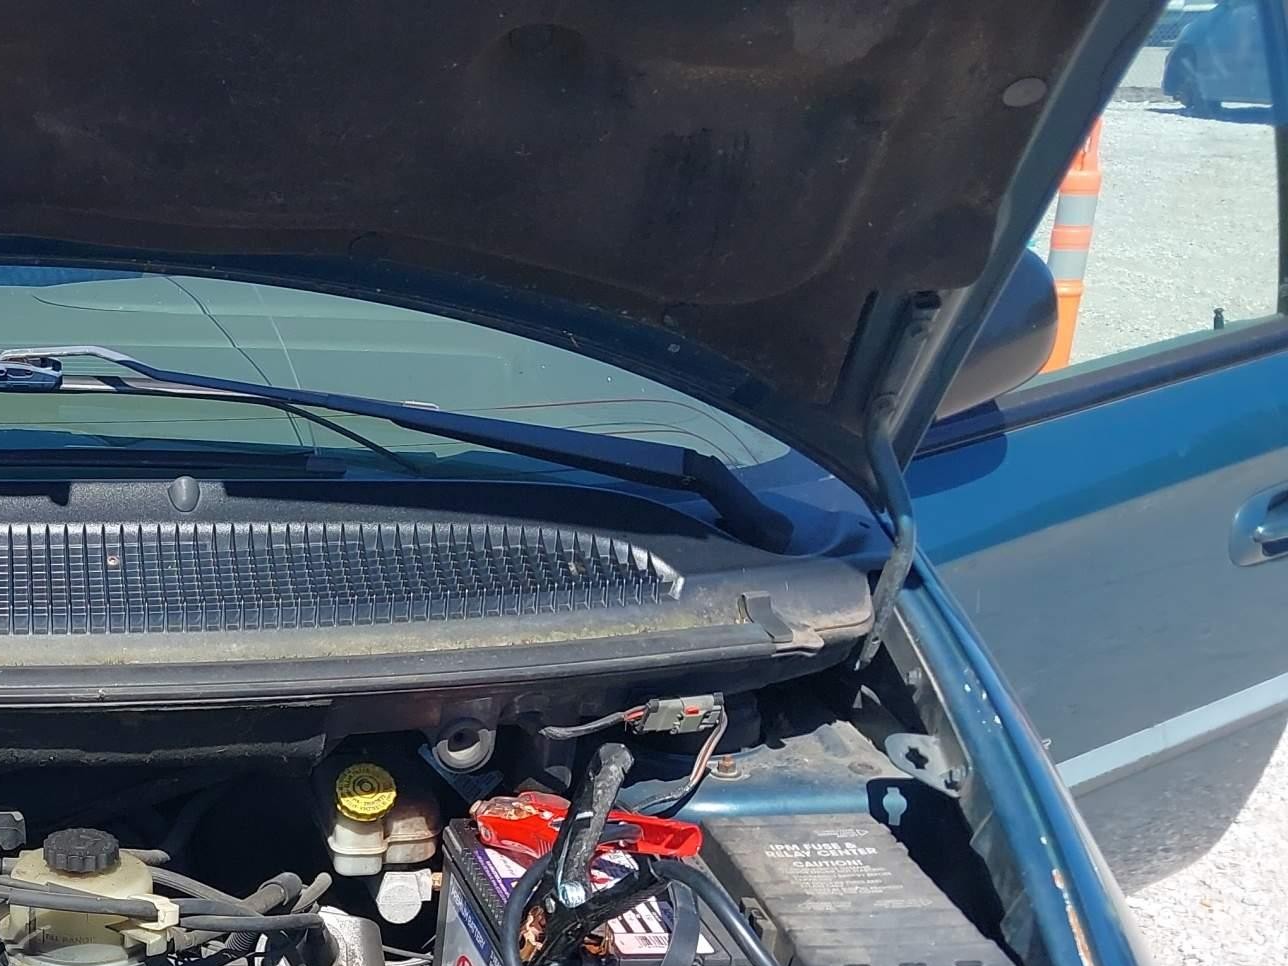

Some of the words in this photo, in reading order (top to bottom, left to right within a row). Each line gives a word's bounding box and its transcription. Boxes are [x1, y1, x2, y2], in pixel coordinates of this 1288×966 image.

[769, 843, 799, 852] IPM
[803, 842, 840, 851] FUSE
[765, 849, 812, 859] RELAY
[816, 847, 878, 857] CENTER
